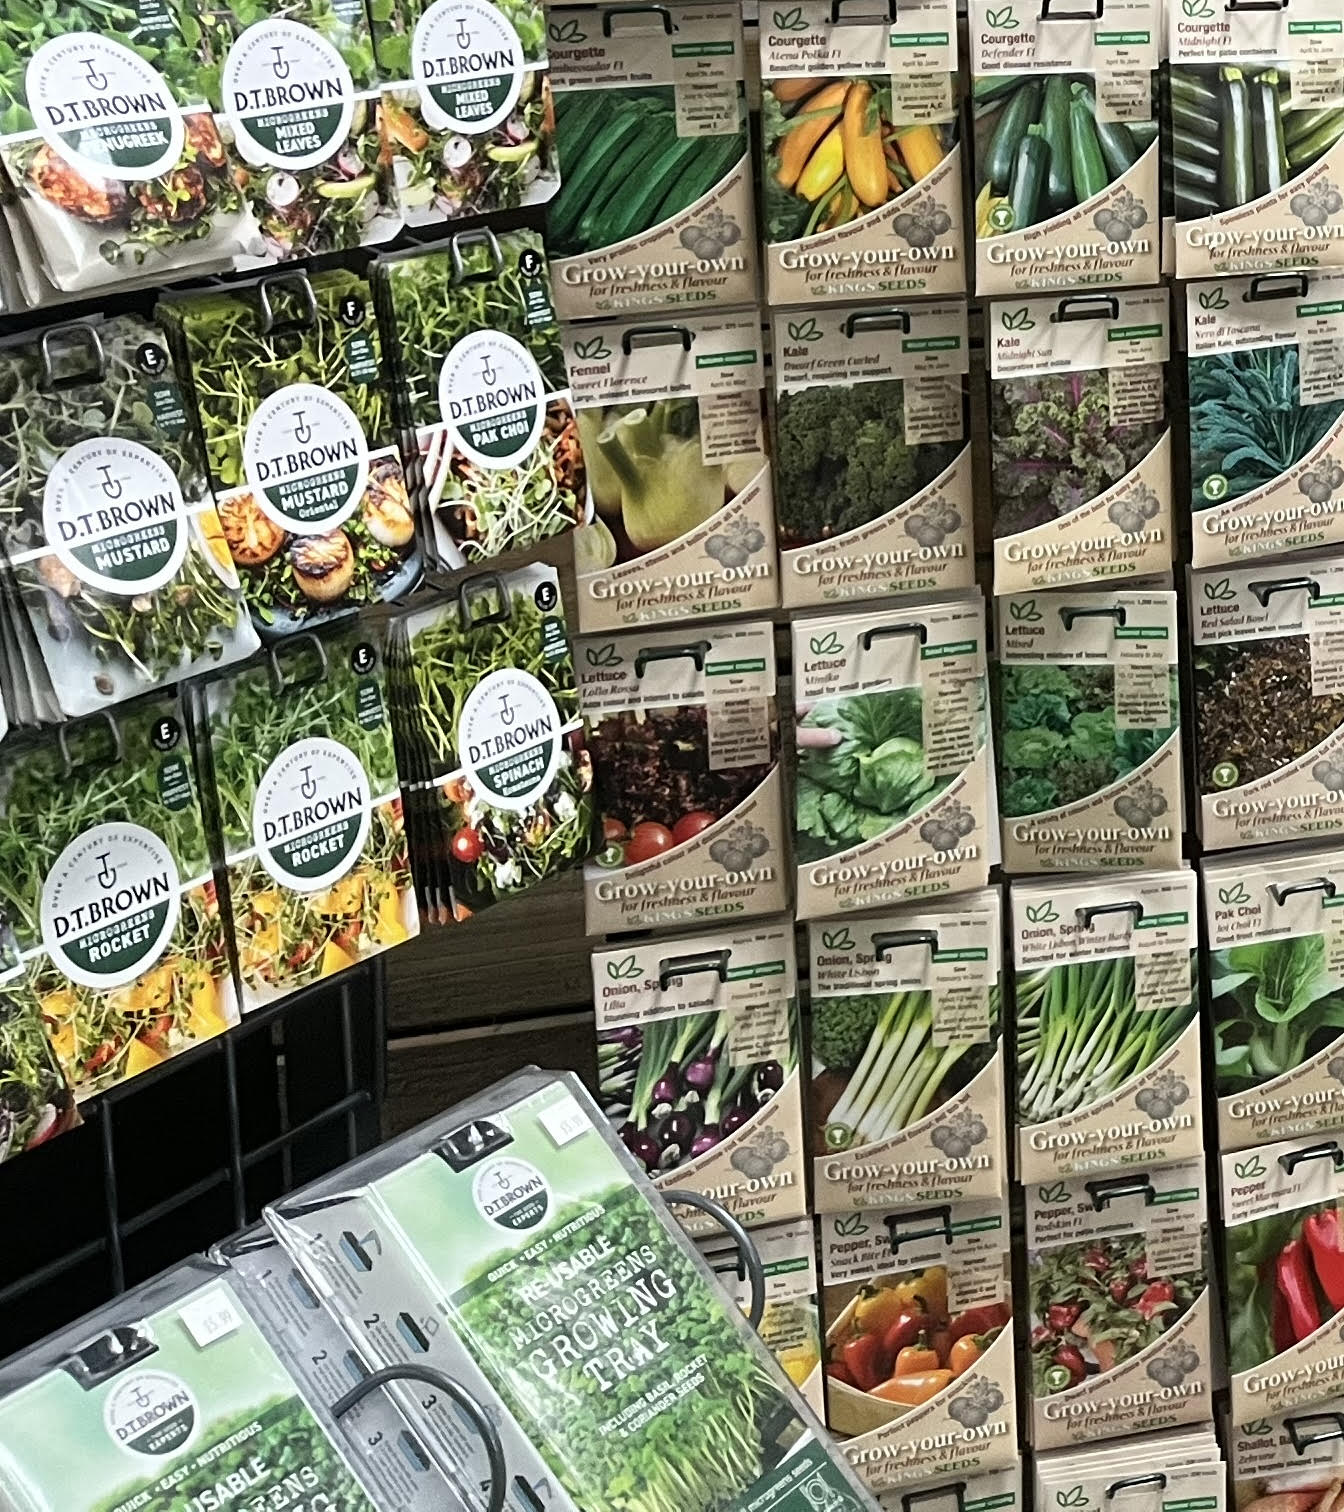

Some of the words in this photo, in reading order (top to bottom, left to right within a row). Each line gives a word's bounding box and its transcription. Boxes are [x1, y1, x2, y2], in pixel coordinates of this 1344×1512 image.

[769, 34, 826, 47] Courgette
[275, 123, 315, 138] MIXED
[276, 136, 322, 154] LEAVES
[570, 364, 610, 377] Fennel
[473, 429, 497, 446] PAK
[500, 423, 530, 442] CHOI
[281, 481, 349, 510] MUSTARD
[95, 537, 171, 570] MUSTARD
[804, 658, 846, 671] Lettuce
[493, 756, 545, 789] SPINACH
[1215, 908, 1234, 921] Pak
[1239, 906, 1261, 918] Choi
[89, 925, 151, 963] ROCKET
[517, 1235, 616, 1305] RE-USABLE
[508, 1245, 657, 1350] MICROGREENS
[528, 1269, 678, 1380] GROWING
[583, 1320, 670, 1391] TRAY
